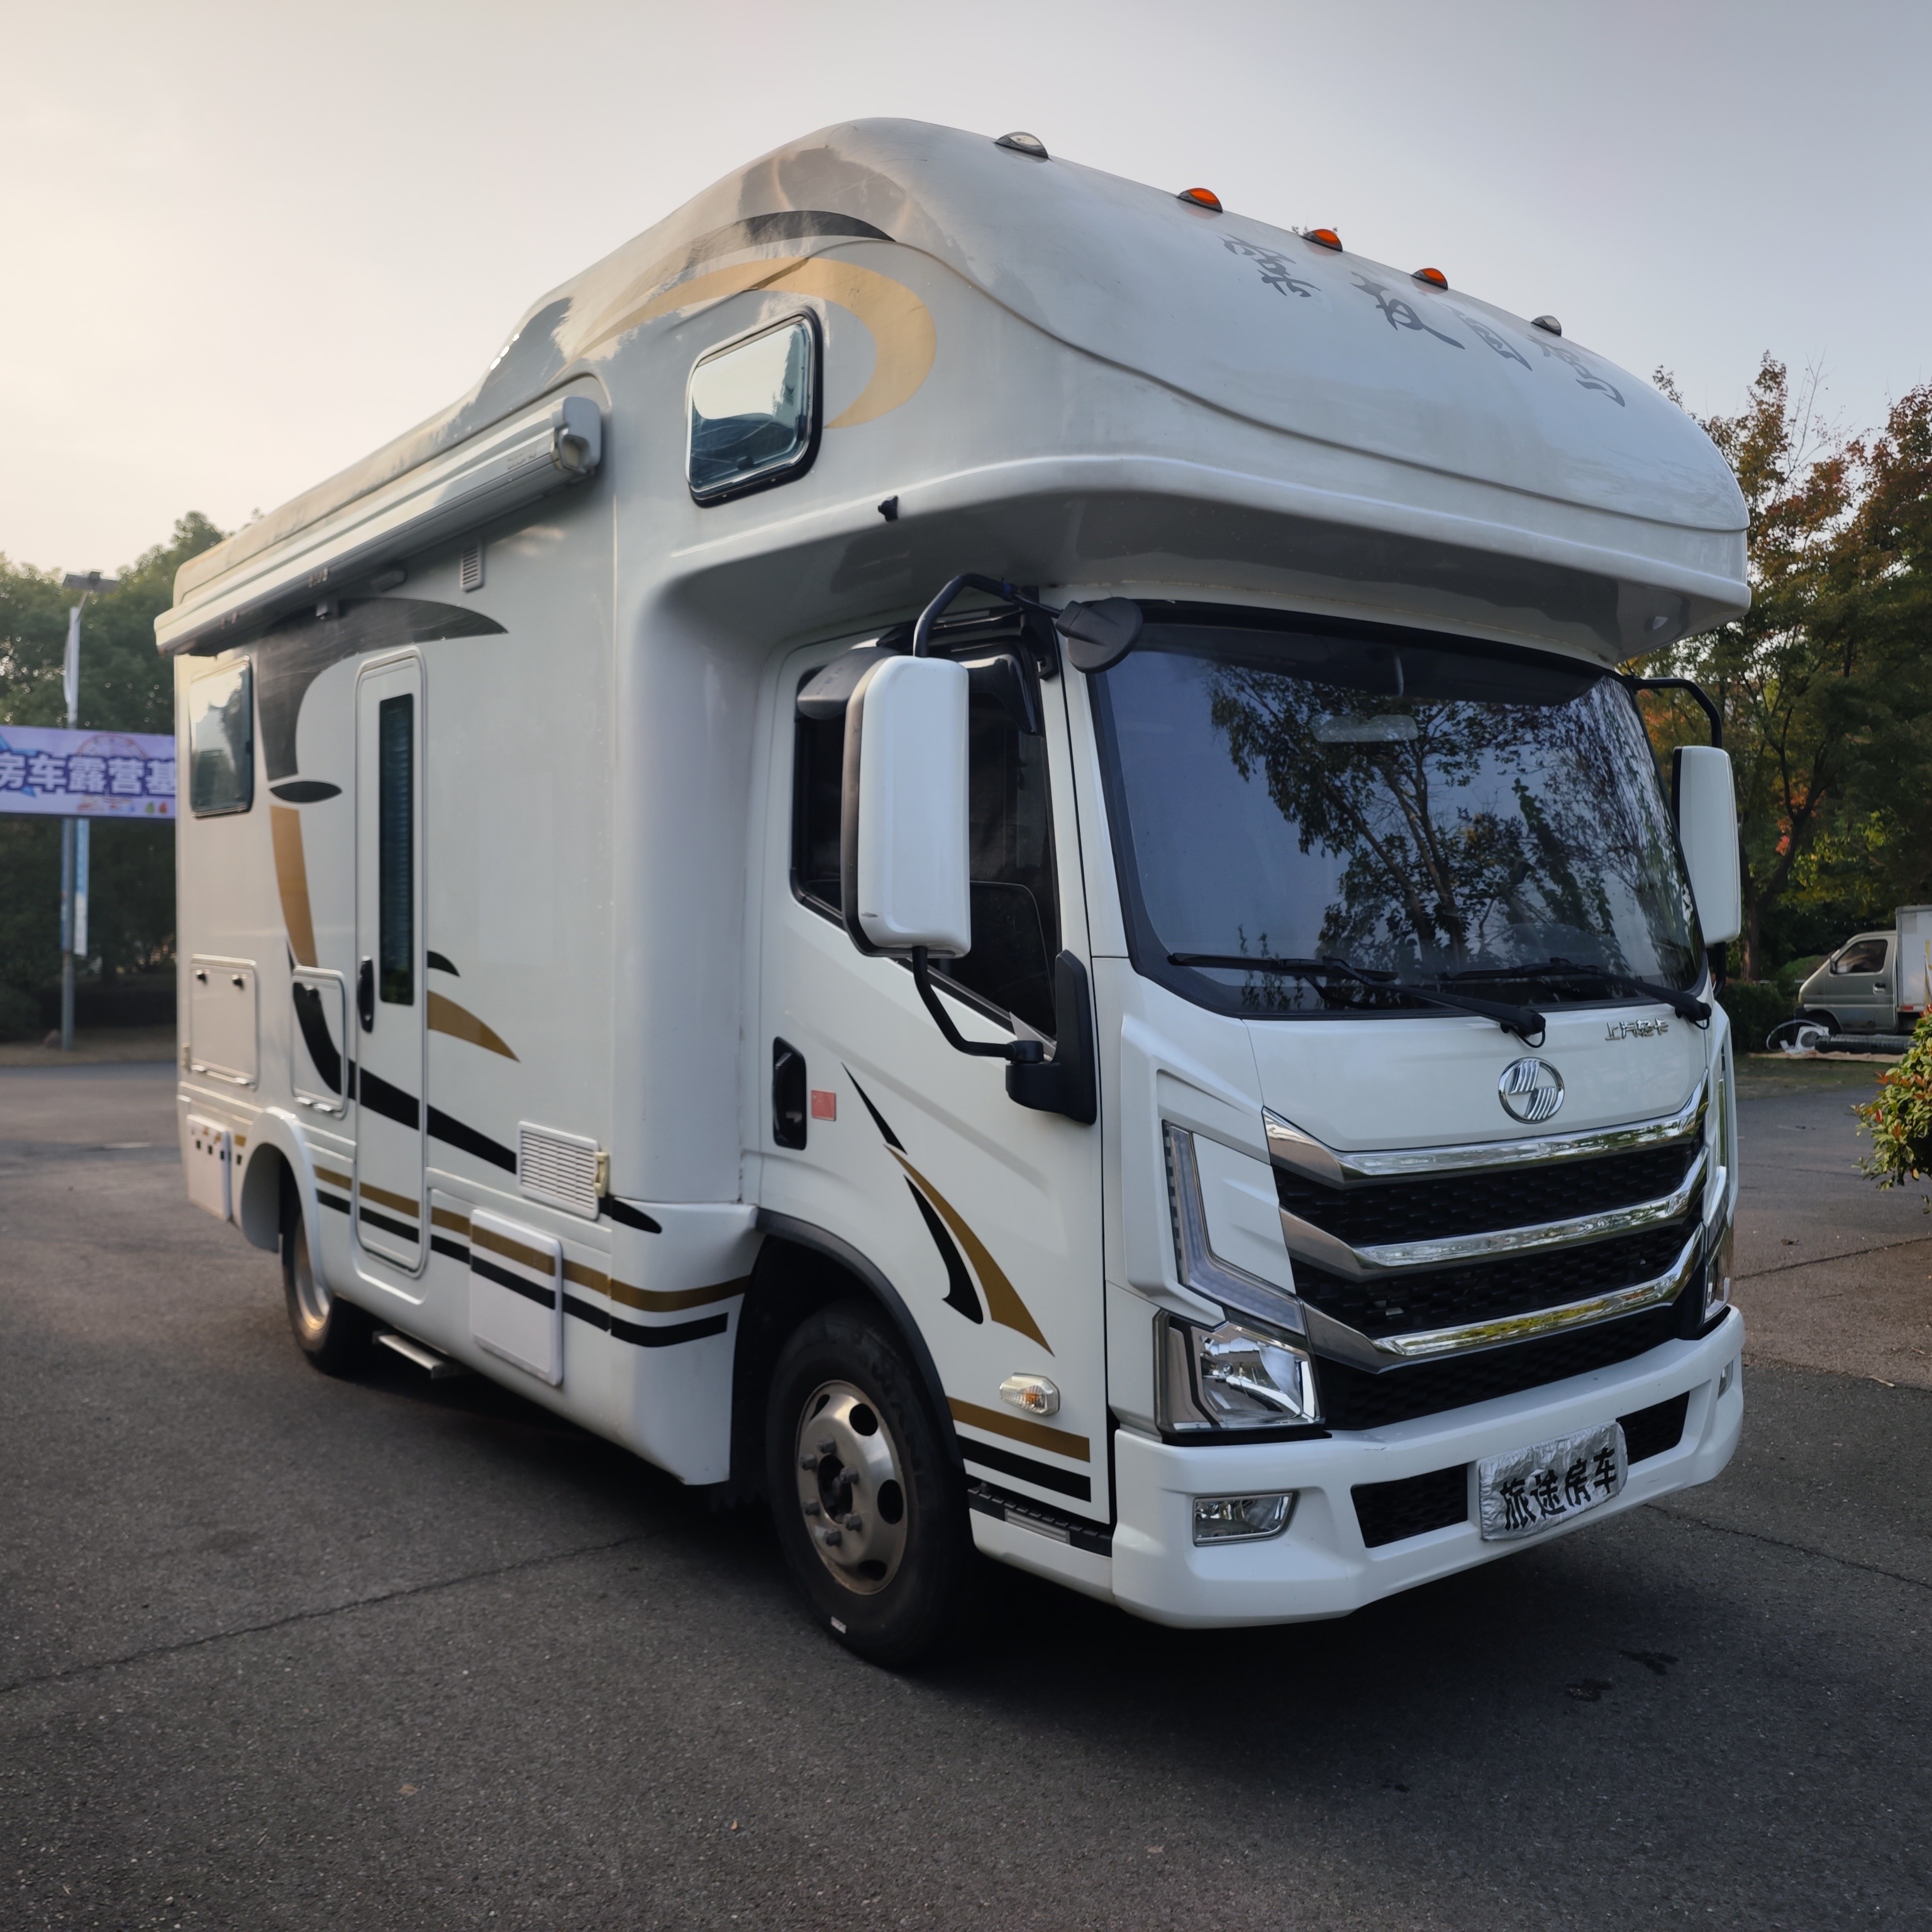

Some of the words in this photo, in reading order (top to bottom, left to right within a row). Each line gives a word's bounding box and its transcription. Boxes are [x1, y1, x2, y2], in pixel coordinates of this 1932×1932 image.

[0, 753, 175, 794] 房车露营基
[1605, 1018, 1668, 1041] 上汽轻卡
[1499, 1447, 1617, 1531] 旅途房车
